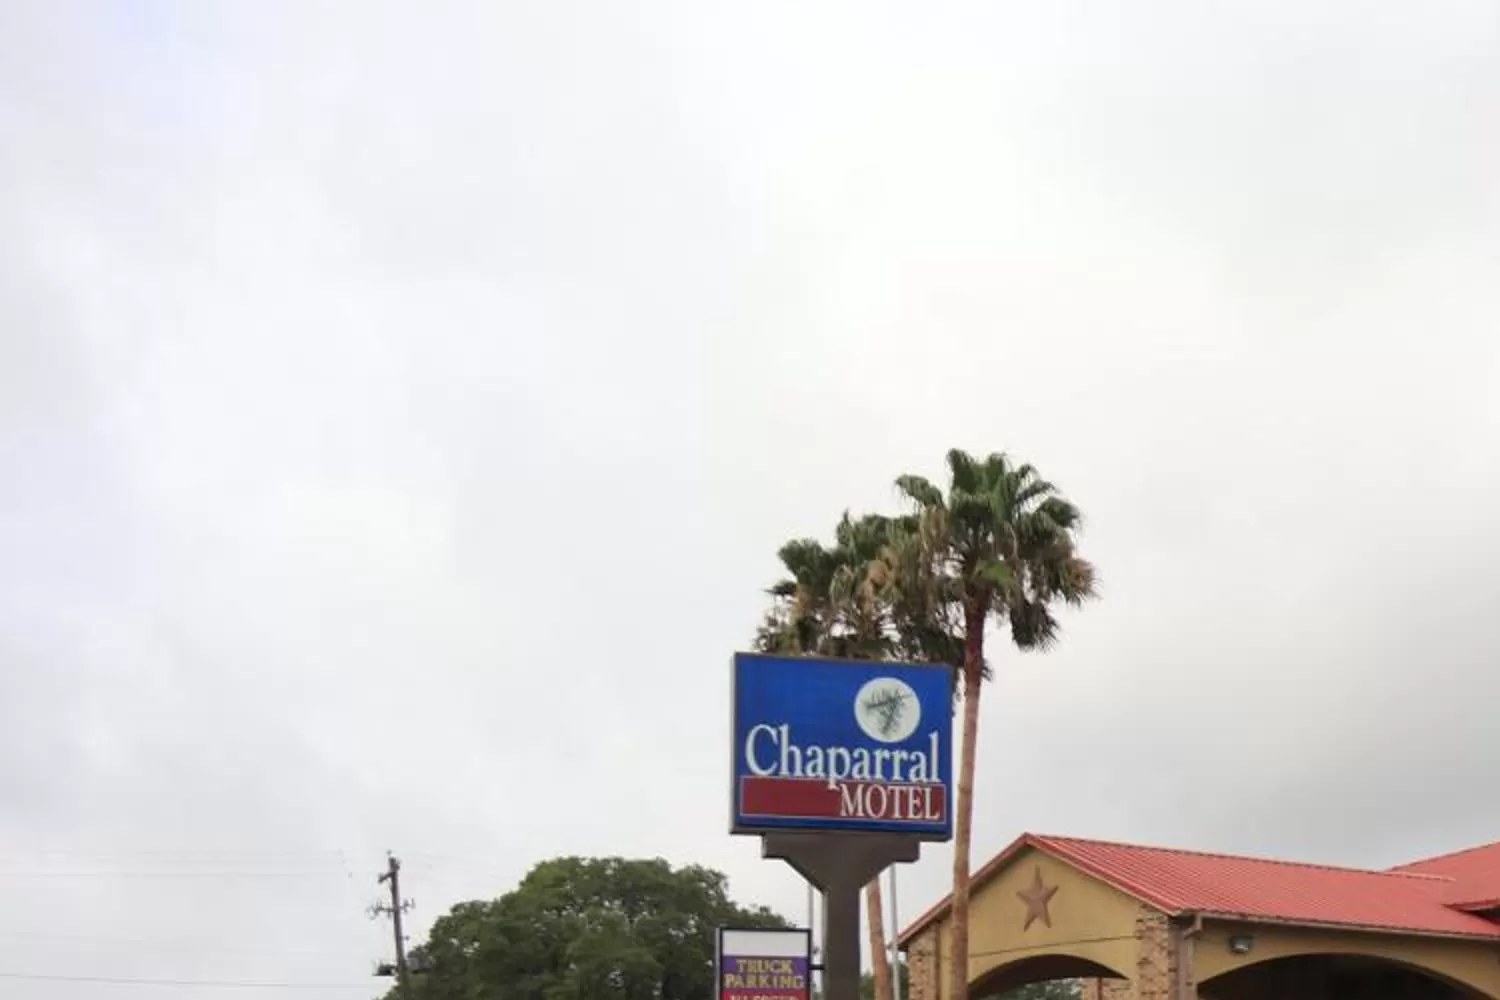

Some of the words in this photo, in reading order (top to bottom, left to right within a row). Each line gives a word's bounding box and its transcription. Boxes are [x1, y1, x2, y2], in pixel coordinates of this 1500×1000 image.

[744, 723, 942, 790] Chaparral
[838, 784, 941, 819] MOTEL
[736, 959, 793, 974] TRUCK
[724, 973, 806, 989] PARKING
